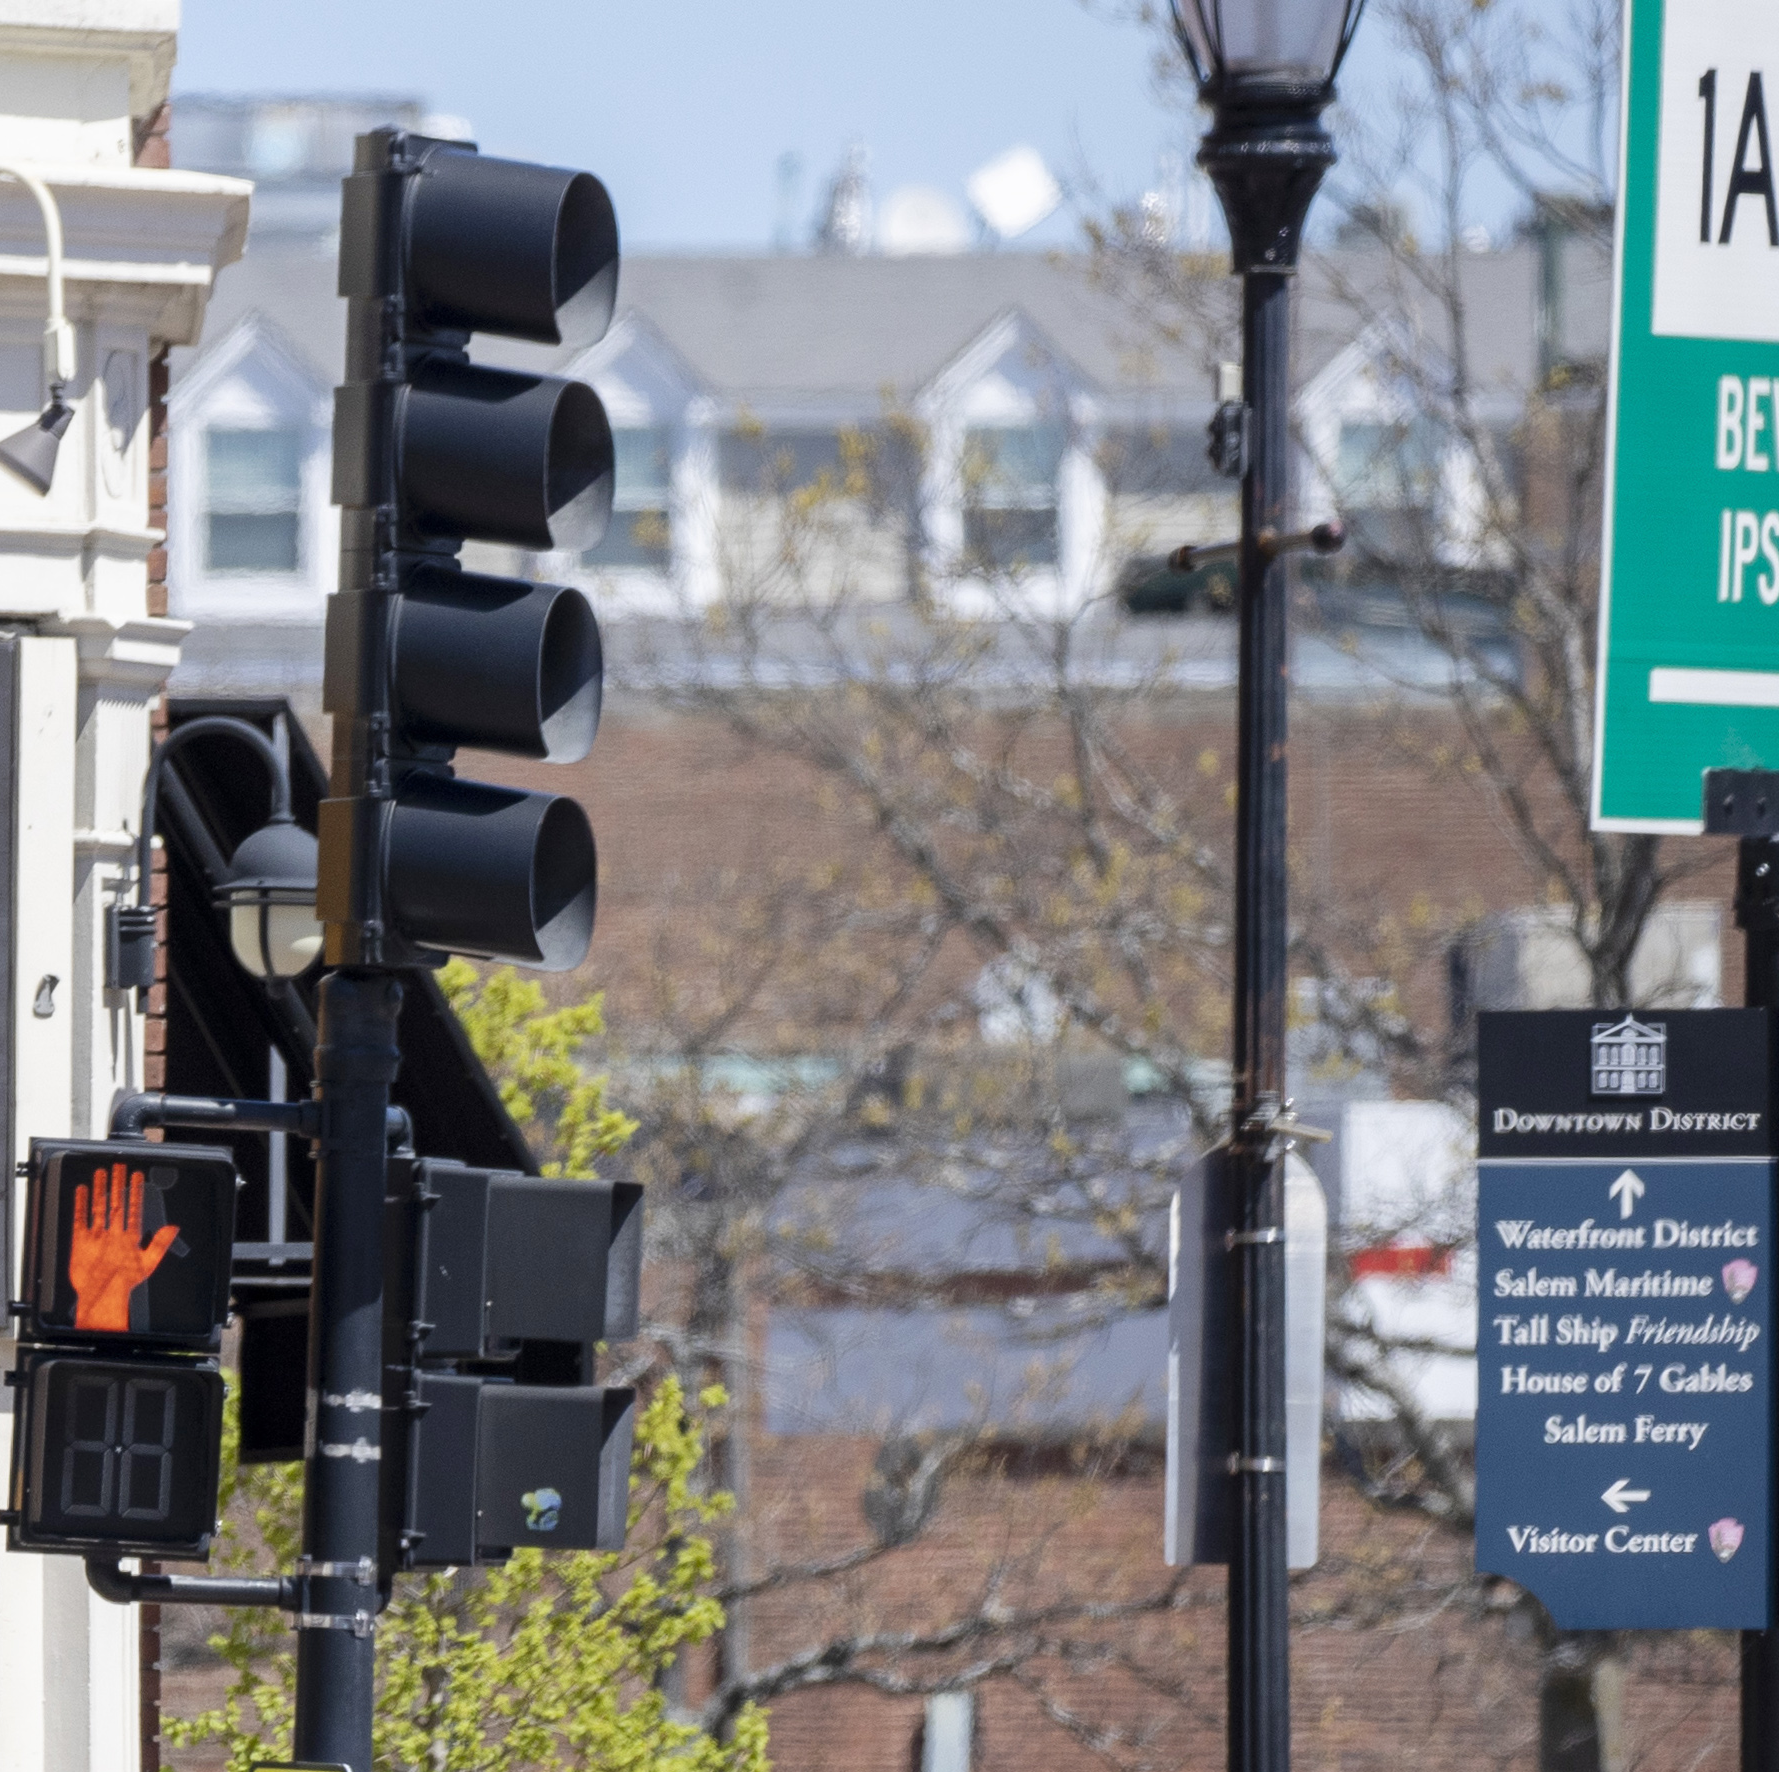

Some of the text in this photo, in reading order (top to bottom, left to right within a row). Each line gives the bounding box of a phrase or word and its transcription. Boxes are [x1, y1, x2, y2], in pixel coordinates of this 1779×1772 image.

[1698, 68, 1779, 247] 1A
[1495, 1218, 1759, 1249] Waterfront District
[1494, 1267, 1714, 1297] Salem Maritime
[1493, 1313, 1761, 1352] Tall Ship Friendship
[1501, 1362, 1753, 1394] House of 7 Gables
[1543, 1413, 1709, 1451] Salem Ferry
[1506, 1525, 1698, 1554] Visitor Center
